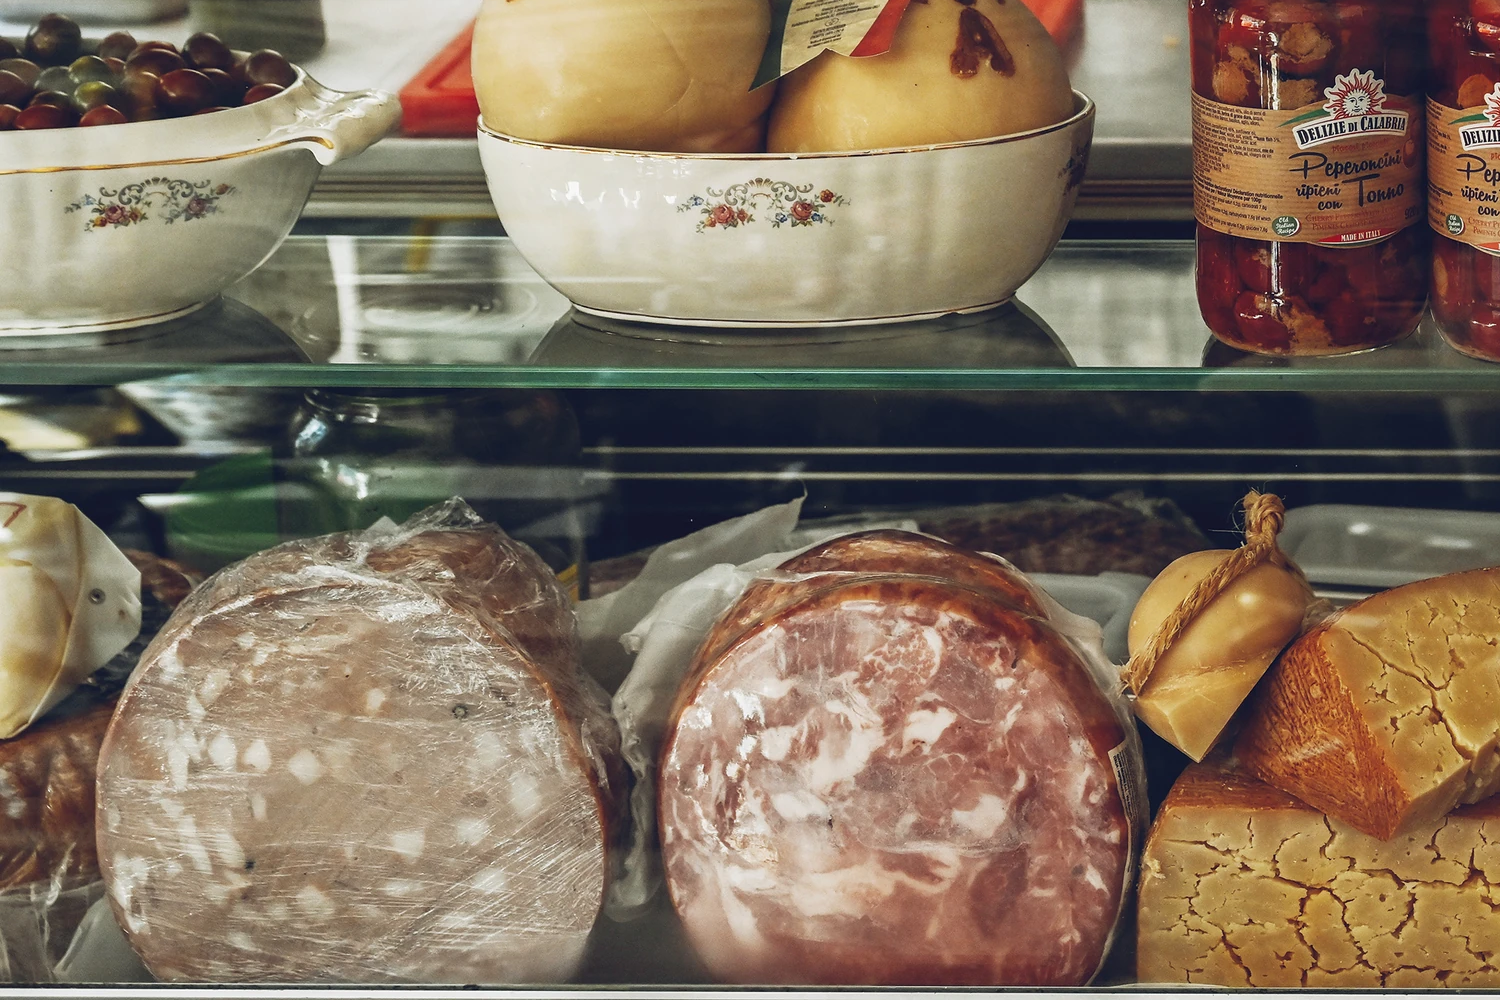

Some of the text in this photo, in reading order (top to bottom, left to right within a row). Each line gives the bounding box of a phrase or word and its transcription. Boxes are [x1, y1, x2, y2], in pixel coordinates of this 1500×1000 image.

[1297, 115, 1406, 145] DELIZIE DI CALABRIA
[1289, 149, 1402, 180] Peperoncini
[1295, 183, 1342, 199] ripieni
[1317, 174, 1404, 210] con Tonno
[1460, 186, 1499, 203] ripieni
[1477, 205, 1500, 217] con
[1340, 229, 1381, 242] MADE IN ITALY
